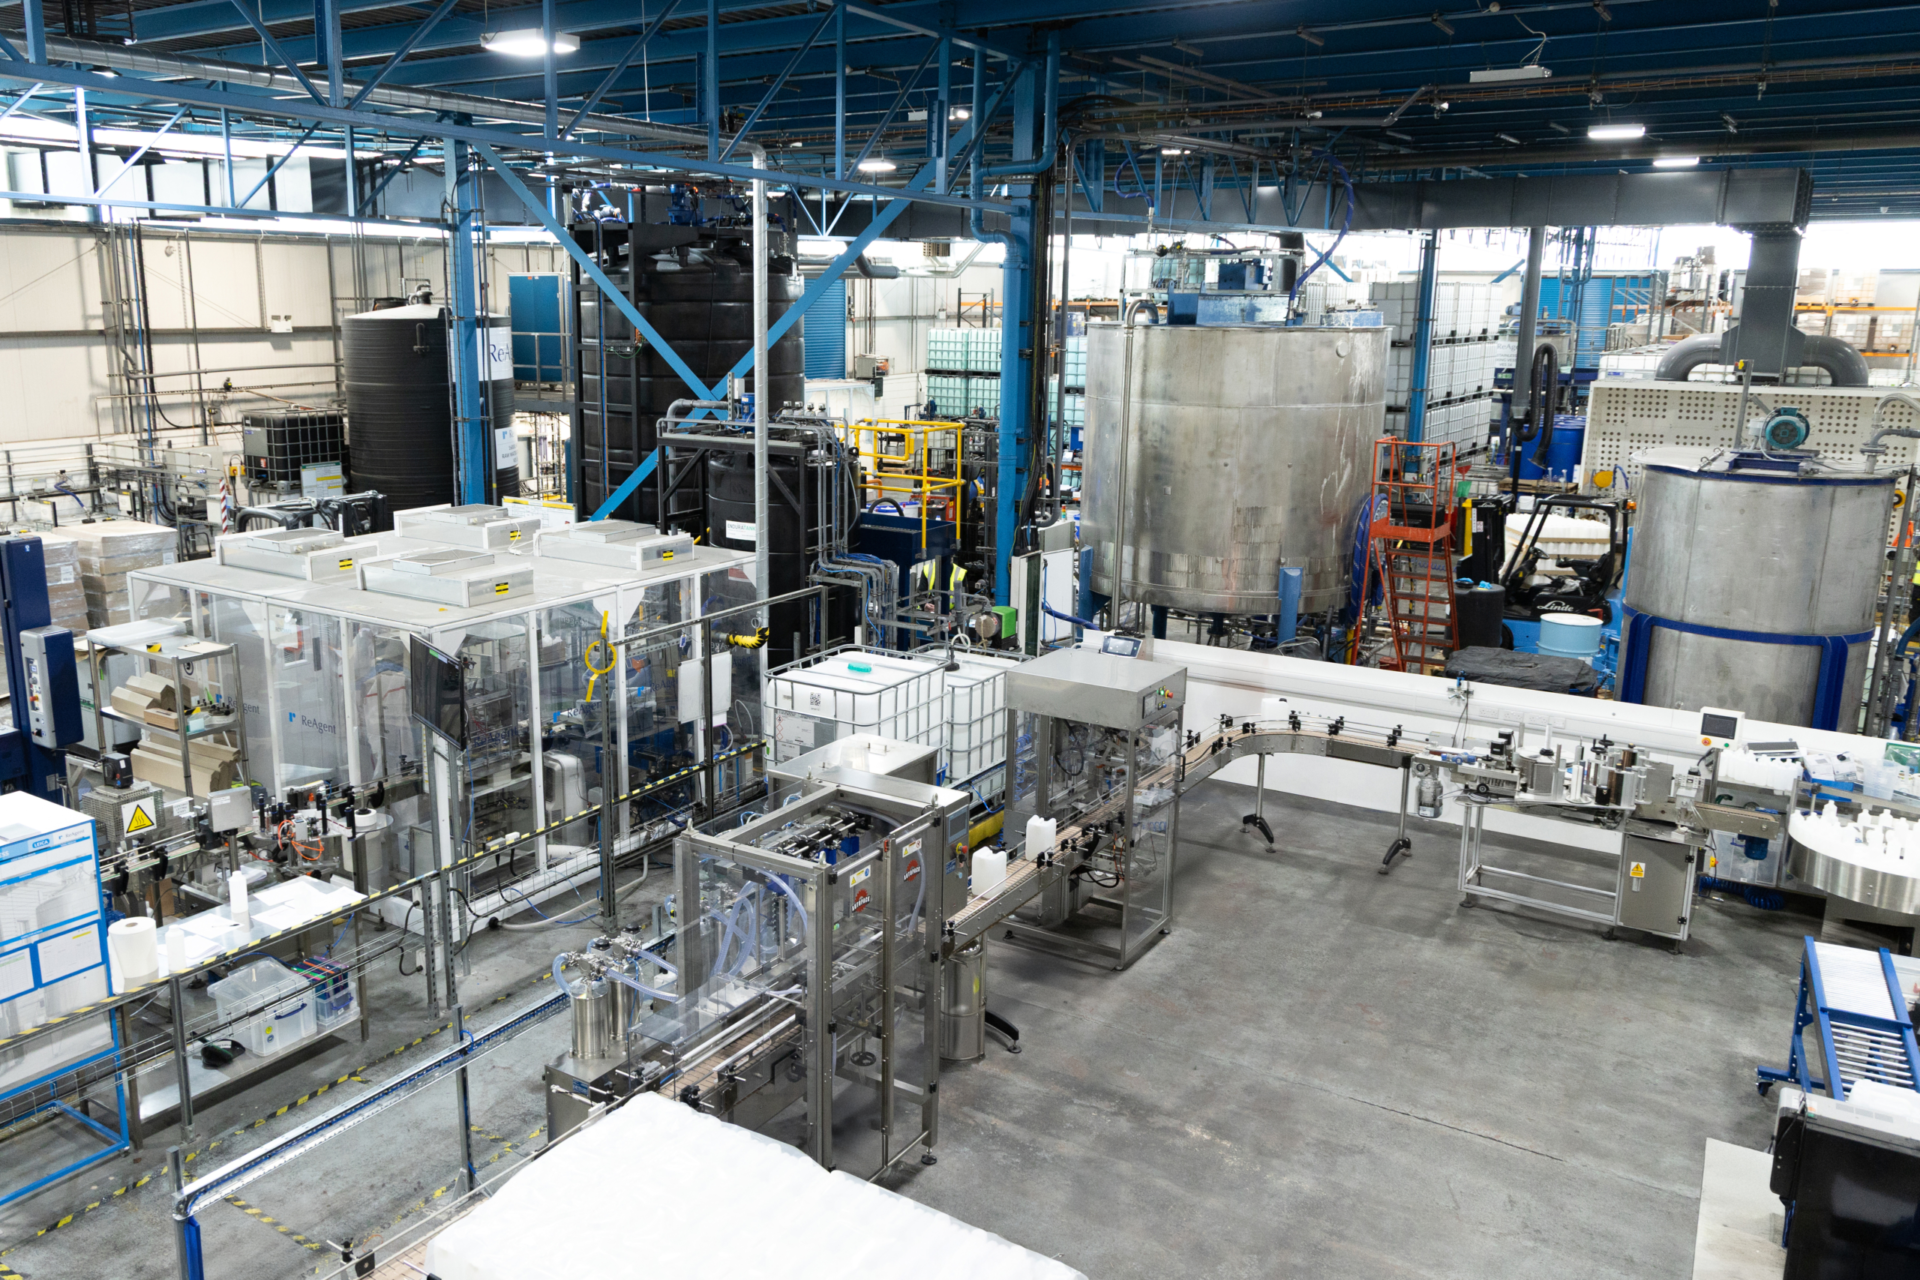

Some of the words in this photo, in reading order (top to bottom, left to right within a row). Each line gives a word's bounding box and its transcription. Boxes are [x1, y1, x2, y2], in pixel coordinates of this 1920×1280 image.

[1536, 600, 1574, 611] Linde
[567, 701, 602, 718] ReAgen
[301, 714, 337, 734] ReAgent
[33, 840, 49, 848] LEICA
